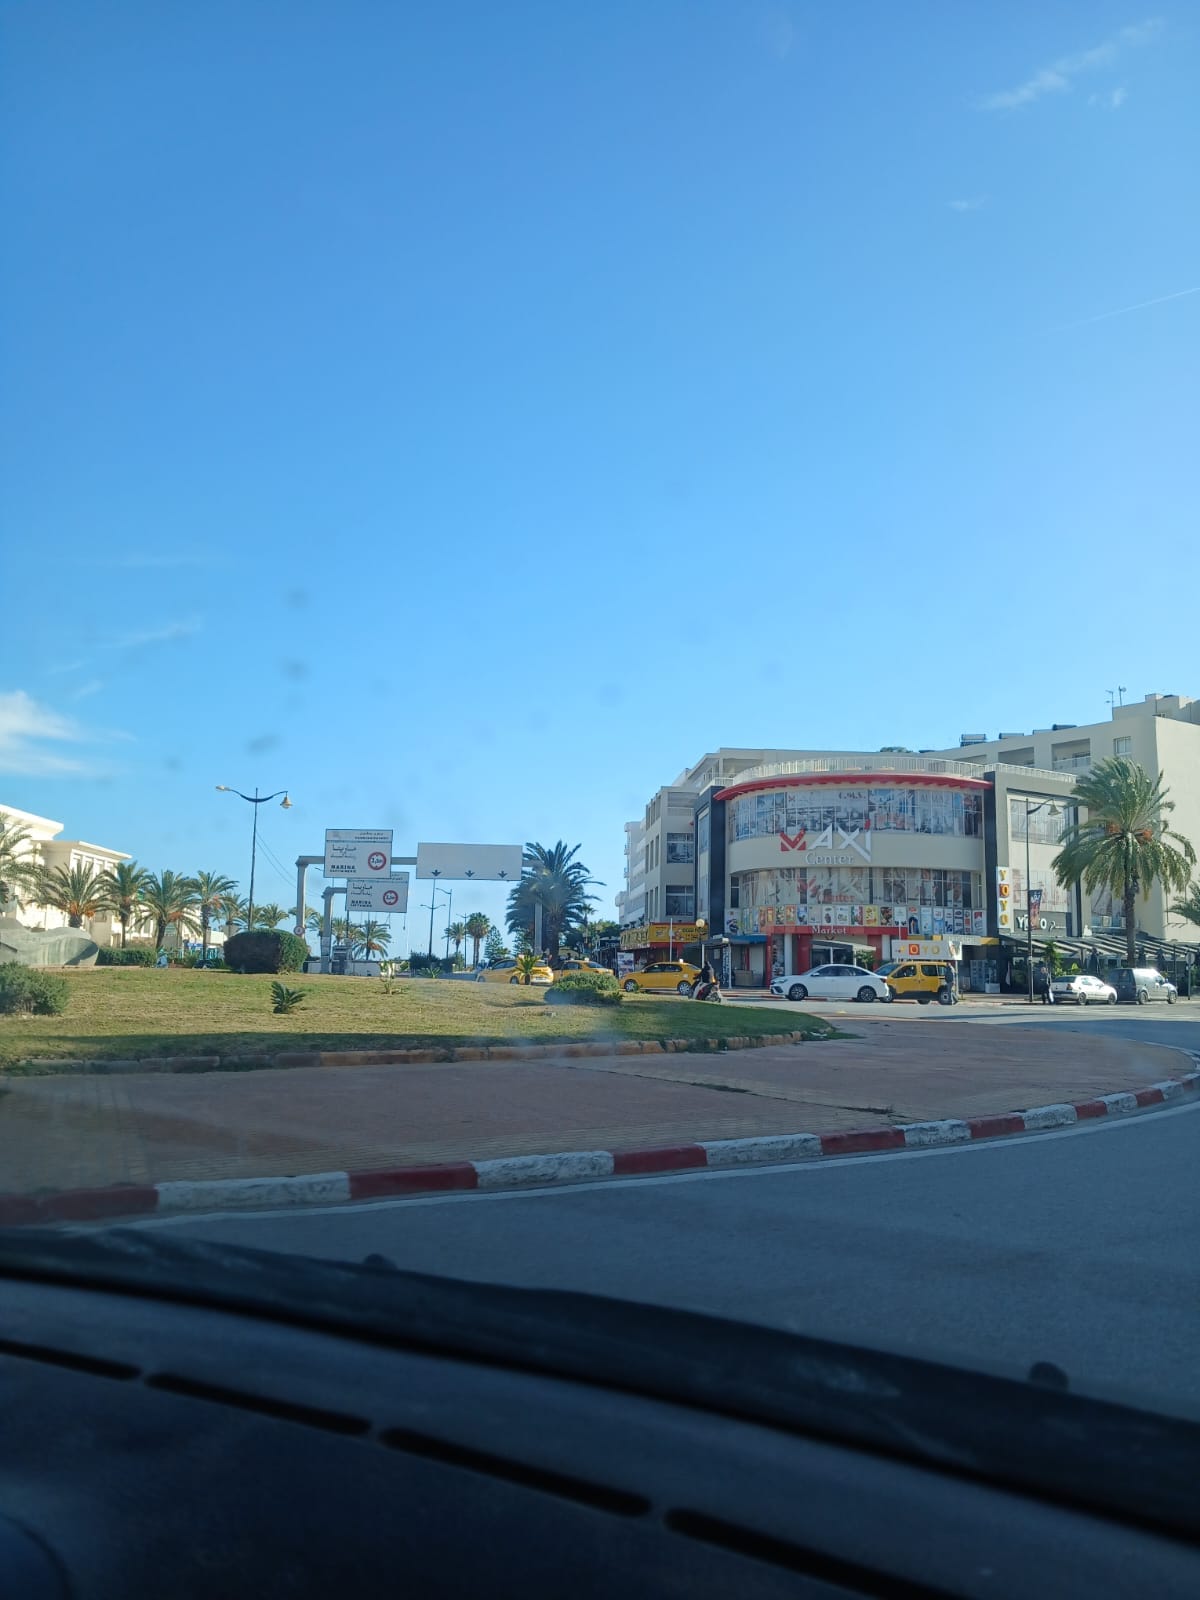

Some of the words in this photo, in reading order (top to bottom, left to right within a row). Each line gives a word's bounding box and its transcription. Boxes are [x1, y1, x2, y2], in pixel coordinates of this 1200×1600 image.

[779, 819, 872, 863] MAXI
[805, 853, 855, 865] Center
[999, 870, 1010, 926] YOYO
[811, 925, 847, 935] Market
